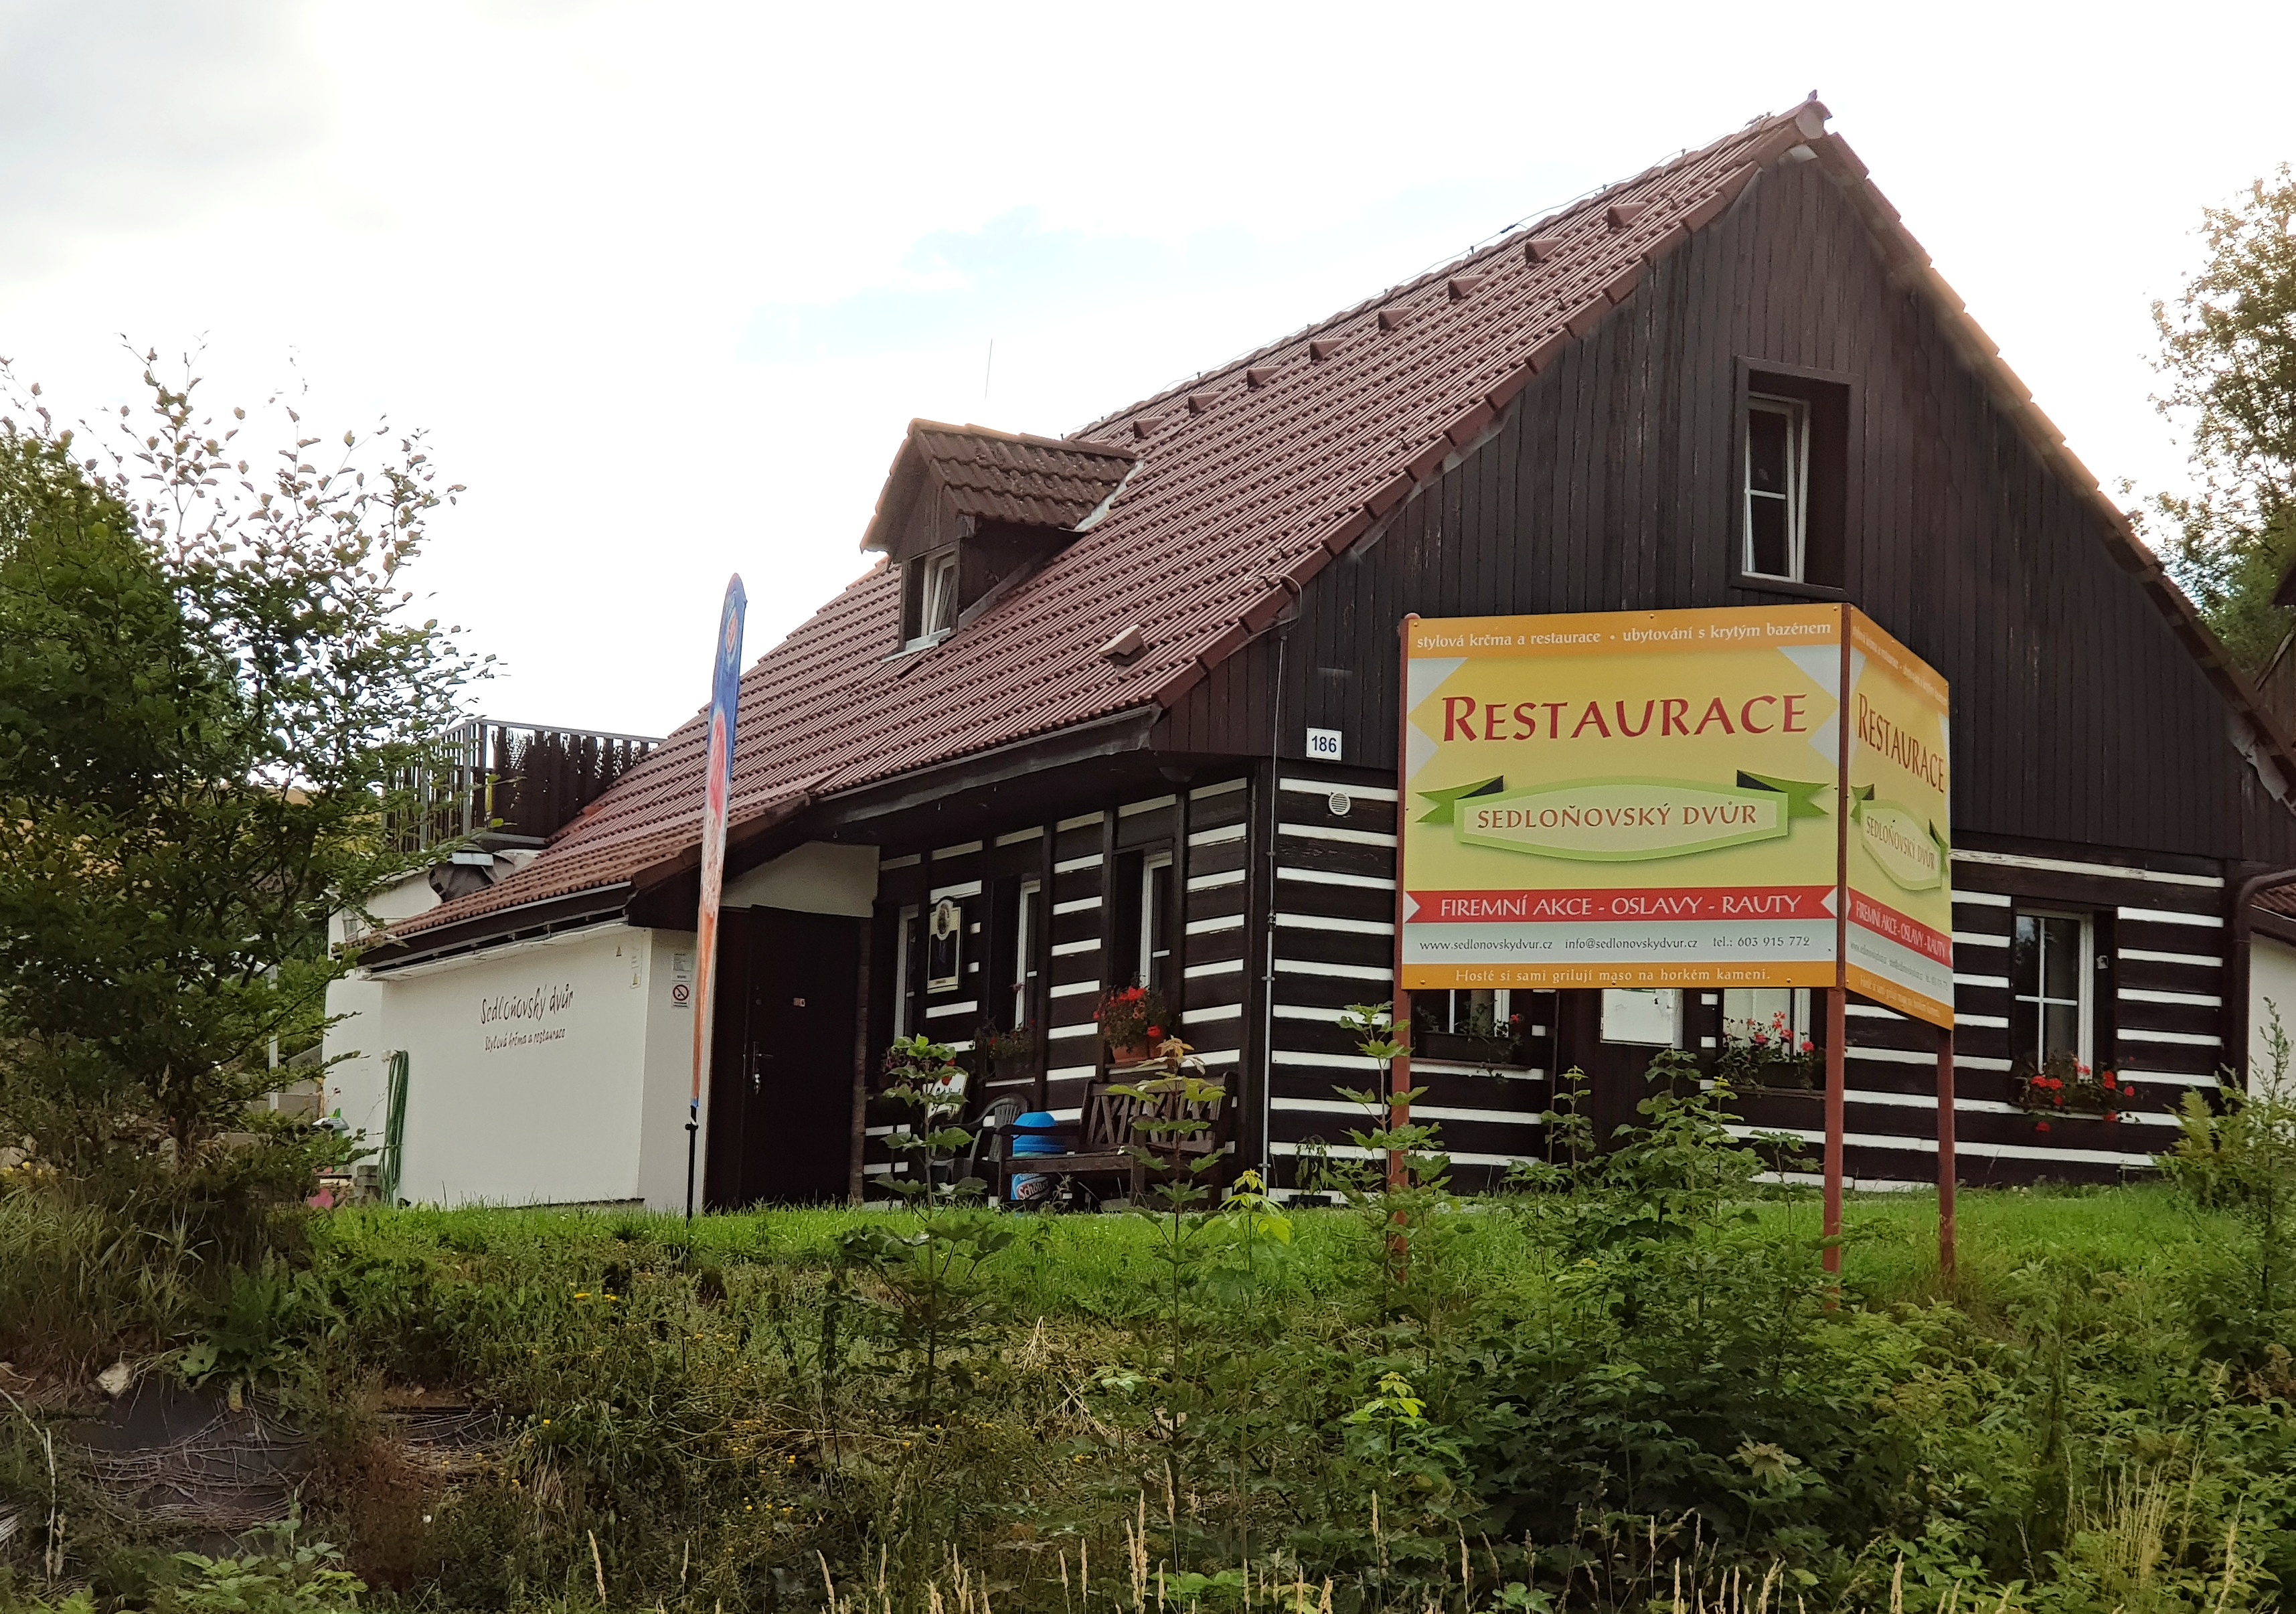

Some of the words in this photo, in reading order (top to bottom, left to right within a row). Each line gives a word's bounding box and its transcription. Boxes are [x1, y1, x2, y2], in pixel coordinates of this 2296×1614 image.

[1417, 634, 1464, 650] stylová
[1469, 633, 1511, 646] krčma
[1517, 635, 1526, 645] a
[1530, 633, 1601, 645] restaurace
[1623, 627, 1693, 643] ubytování
[1698, 628, 1706, 639] s
[1710, 625, 1760, 641] krytým
[1767, 622, 1831, 636] bazénem
[1441, 693, 1807, 742] RESTAURACE
[1311, 735, 1337, 753] 186
[1858, 692, 1945, 793] RESTAURACE
[1477, 803, 1671, 829] SEDLOŇOVSKÝ
[1682, 801, 1757, 825] DVŮR
[1441, 894, 1528, 916] FIREMNÍ
[1533, 898, 1592, 916] AKCE
[1611, 896, 1703, 915] OSLAVY
[1722, 895, 1803, 914] RAUTY
[1420, 939, 1553, 951] www.sedlonovskydvur.cz
[1565, 937, 1698, 951] info@sedlonovskydvur.cz
[1713, 937, 1732, 947] tel.:
[1738, 937, 1758, 947] 603
[1763, 937, 1784, 947] 915
[1789, 937, 1810, 947] 772
[1881, 913, 1897, 936] AKCE
[1900, 923, 1924, 949] OSLAVY
[1456, 970, 1495, 981] Hosté
[1499, 971, 1510, 981] si
[1552, 969, 1592, 983] grilují
[1599, 971, 1632, 981] maso
[1639, 971, 1654, 981] na
[1661, 969, 1710, 981] horkém
[1716, 968, 1771, 980] kameni.
[550, 983, 573, 1014] dvůr
